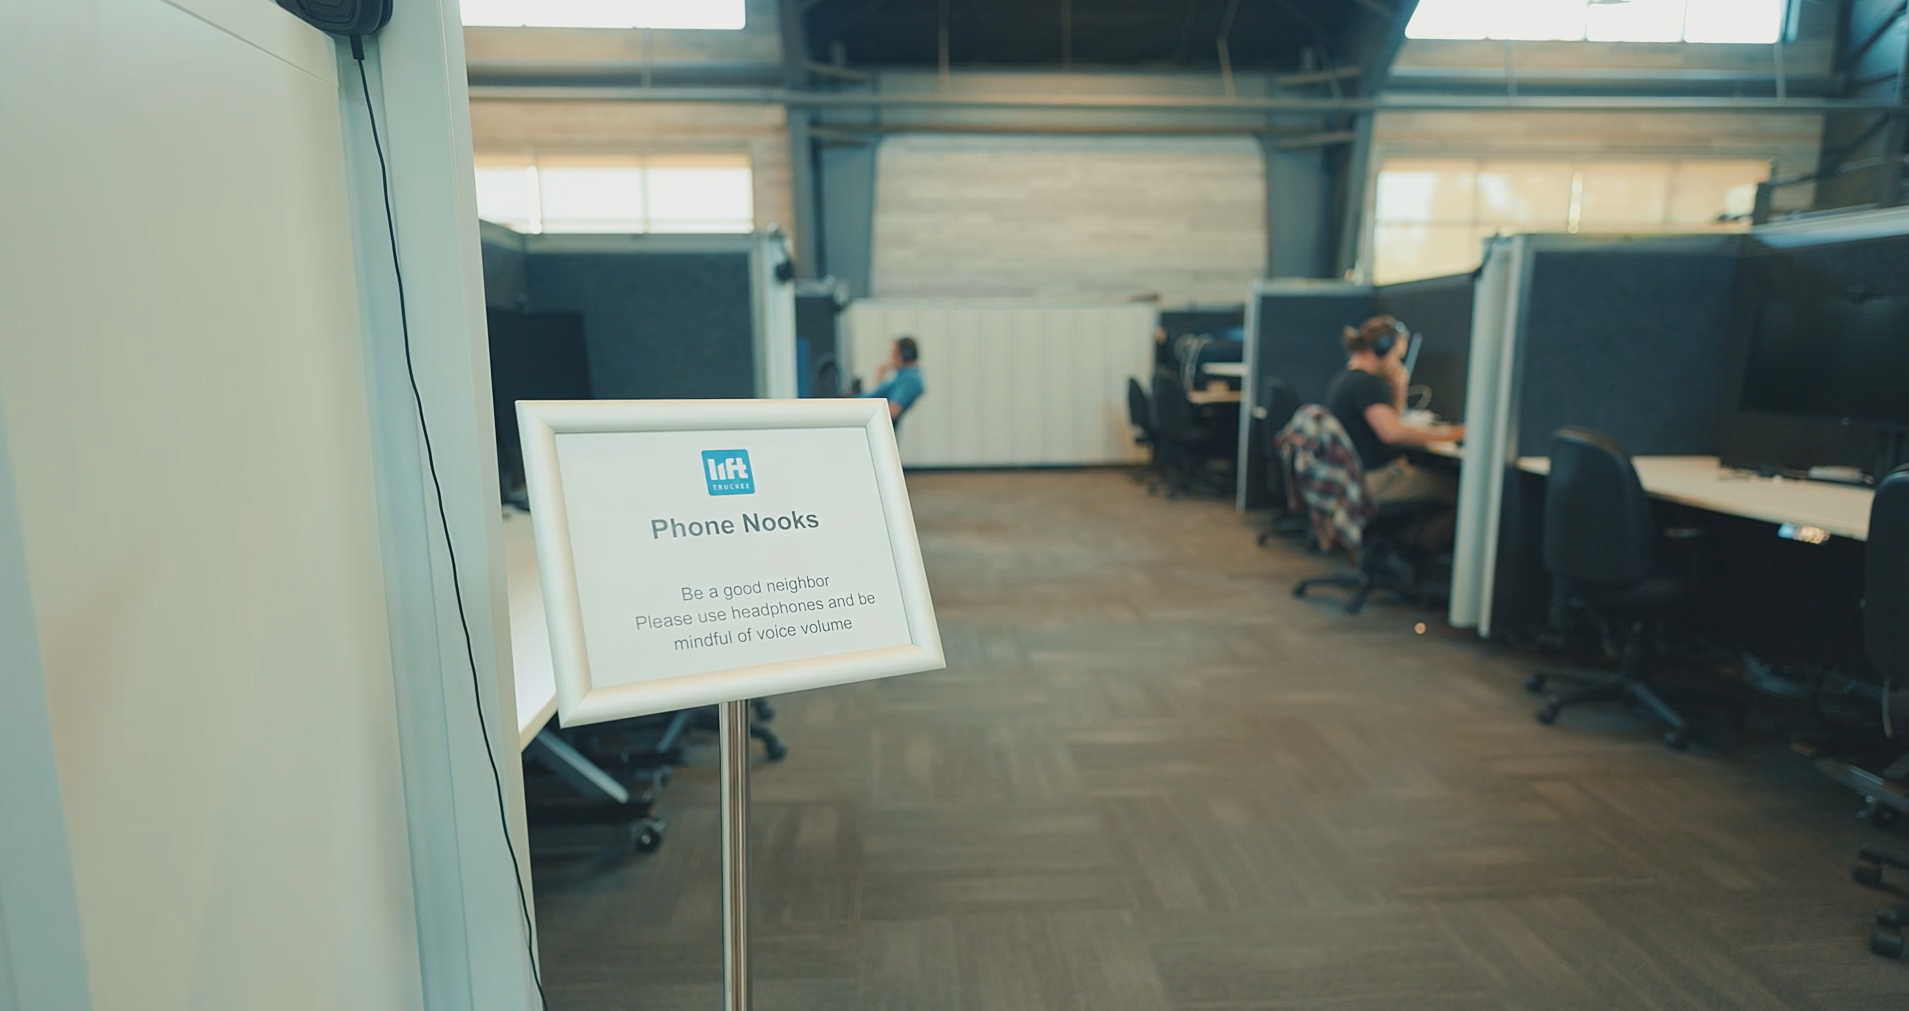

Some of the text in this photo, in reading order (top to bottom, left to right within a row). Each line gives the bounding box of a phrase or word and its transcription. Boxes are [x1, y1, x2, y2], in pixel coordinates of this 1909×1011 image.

[707, 457, 749, 481] lift
[712, 482, 751, 491] TRUCKEE
[651, 510, 820, 540] Phone Nooks
[681, 575, 830, 601] Be a good neighbor
[635, 592, 876, 631] Please use headphones and be
[674, 618, 853, 651] mindful of voice volume
